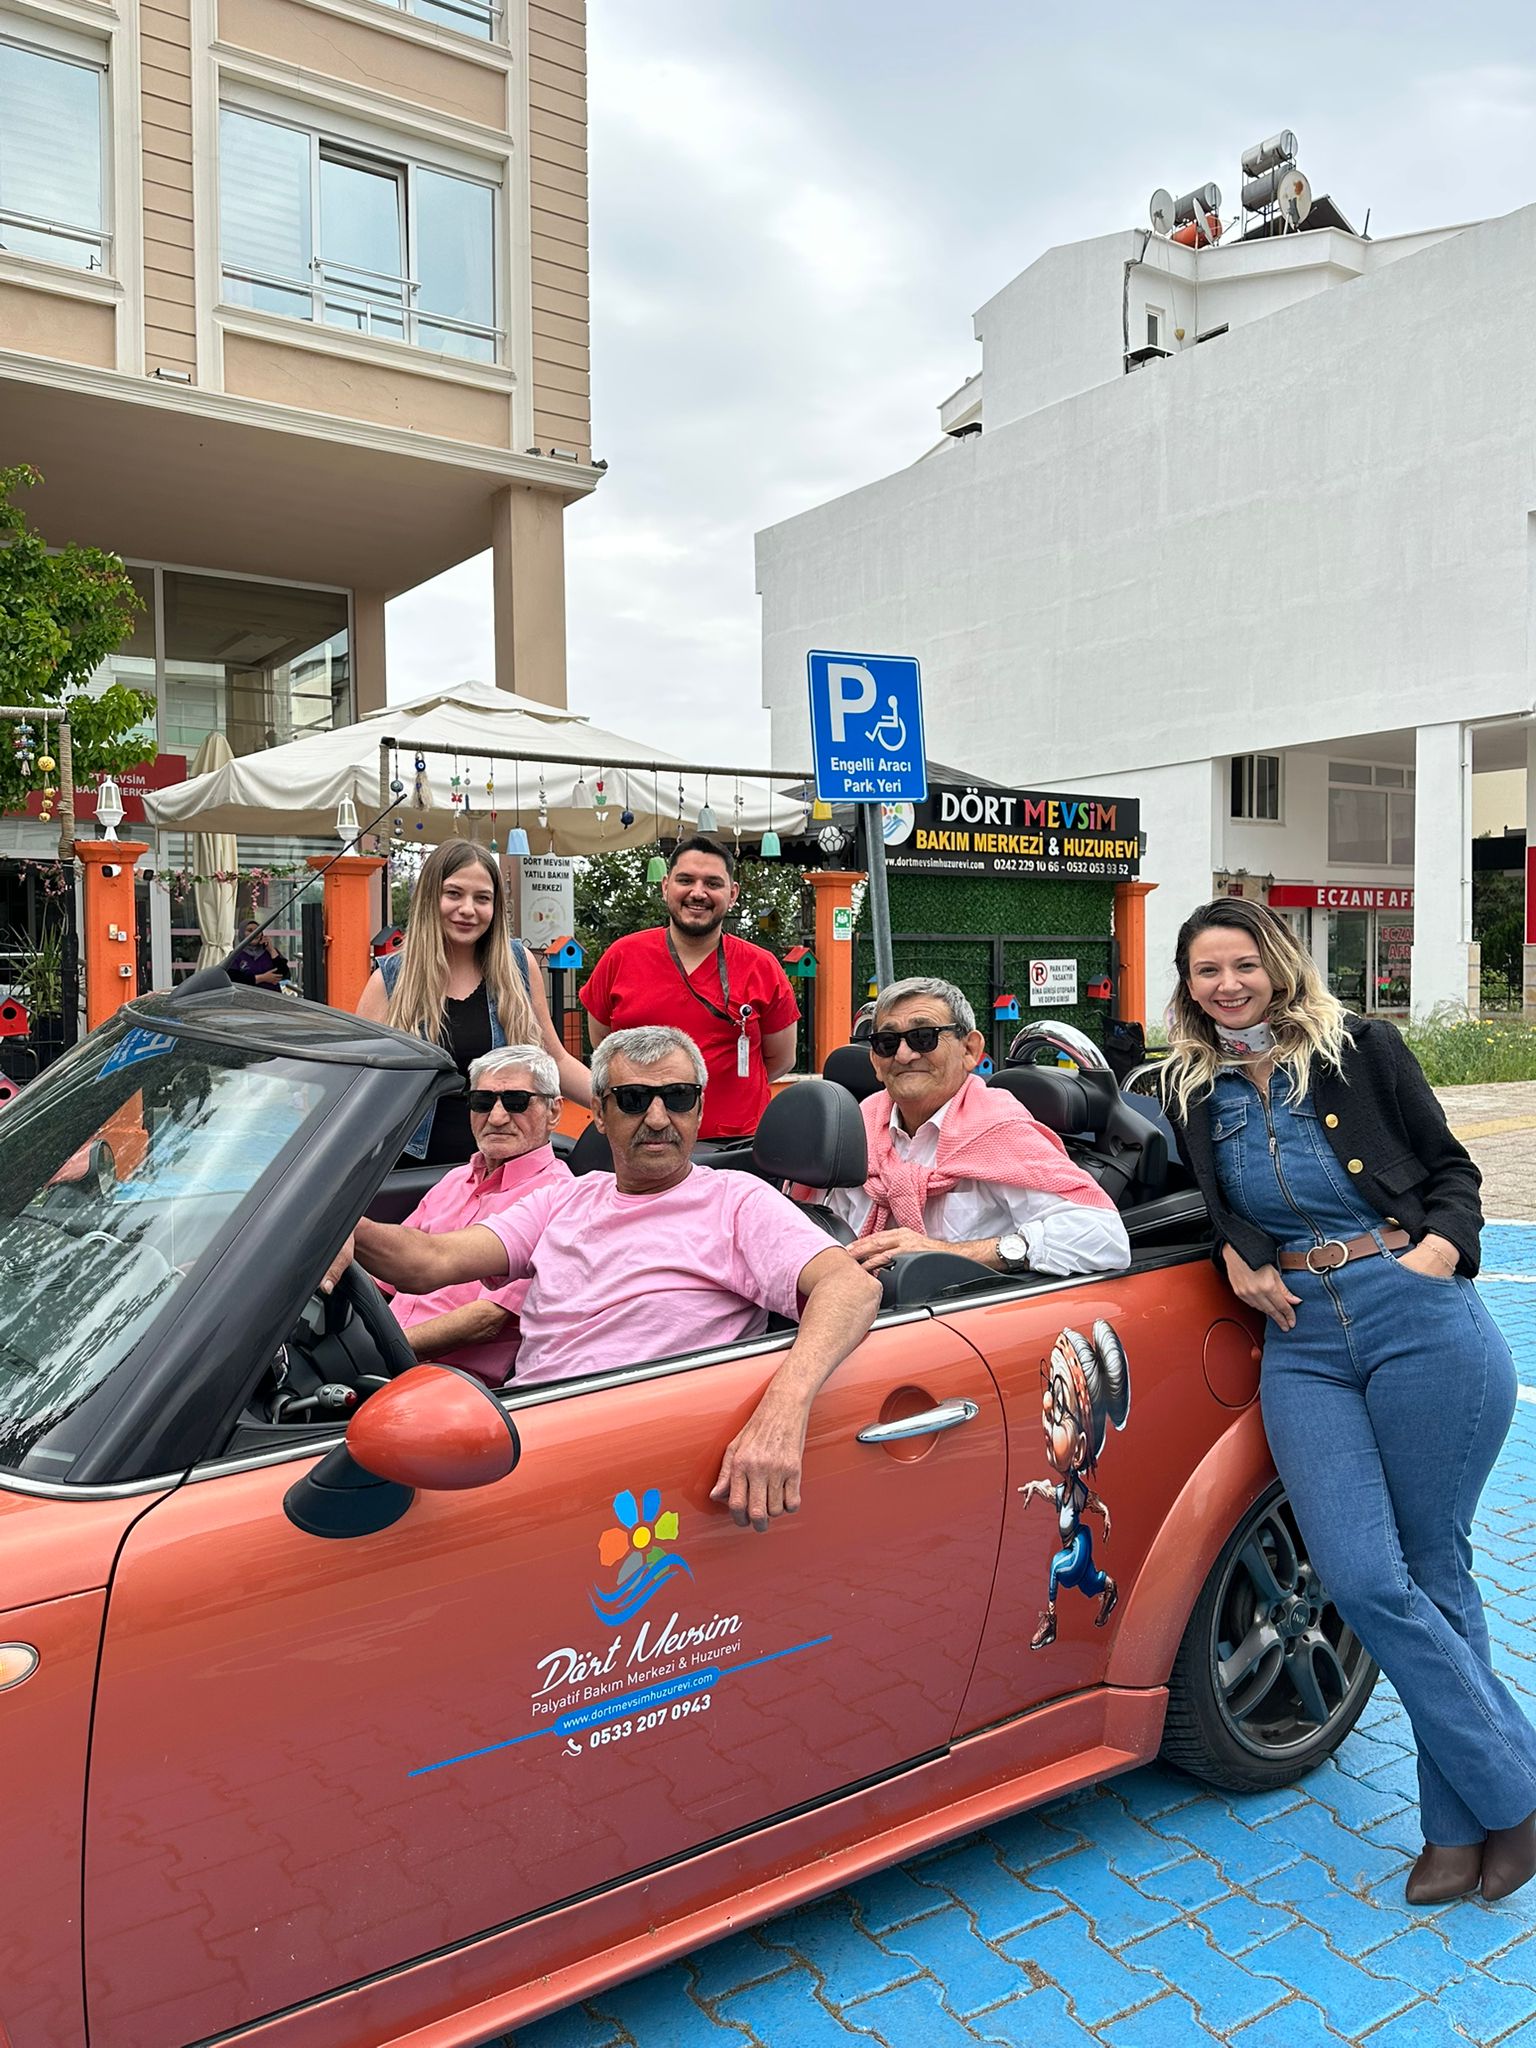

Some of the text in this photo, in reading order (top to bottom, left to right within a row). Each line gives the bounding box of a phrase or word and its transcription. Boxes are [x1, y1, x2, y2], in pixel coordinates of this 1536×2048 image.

[827, 662, 877, 742] P
[830, 757, 912, 775] Engelli Aracı
[843, 778, 902, 793] Park Yeri
[940, 787, 1017, 827] DÖRT
[915, 829, 1139, 860] BAKIM MERKEZİ & HUZUREVİ
[524, 870, 569, 880] YATILI BAKIM
[993, 858, 1017, 871] 0242
[1018, 859, 1035, 872] 229
[1036, 860, 1047, 872] 10
[1066, 861, 1088, 873] 0532
[1088, 862, 1105, 874] 053
[1118, 864, 1129, 875] 52
[531, 883, 562, 892] MERKEZİ
[1317, 888, 1385, 906] ECZANE
[626, 1611, 743, 1668] Mevsim
[531, 1638, 741, 1716] Palyatif Bakım Merkezi & Huzurevi
[562, 1672, 713, 1729] www.dortmevsimhuzurevi.com
[589, 1693, 712, 1749] 0533 207 0943
